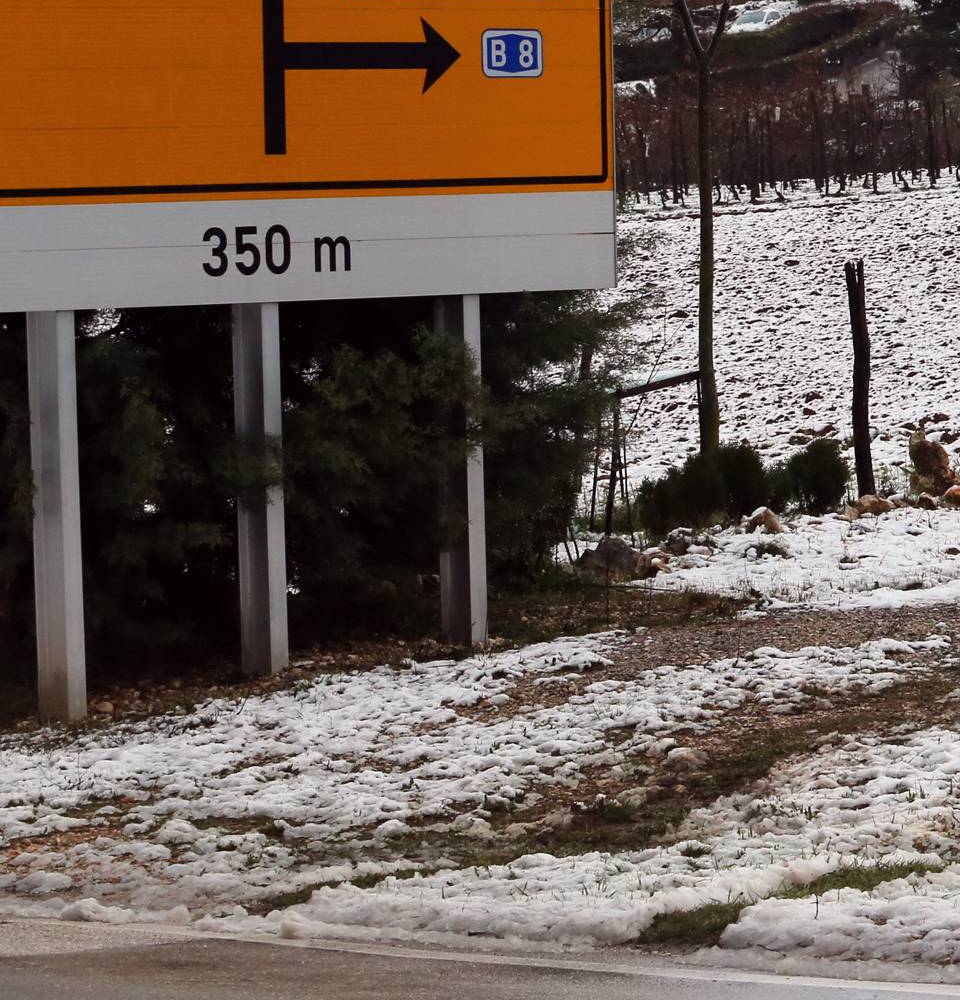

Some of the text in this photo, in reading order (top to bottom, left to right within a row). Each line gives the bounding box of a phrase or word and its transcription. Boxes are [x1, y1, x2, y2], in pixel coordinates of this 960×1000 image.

[491, 39, 534, 68] B 8
[202, 223, 352, 277] 350 m
